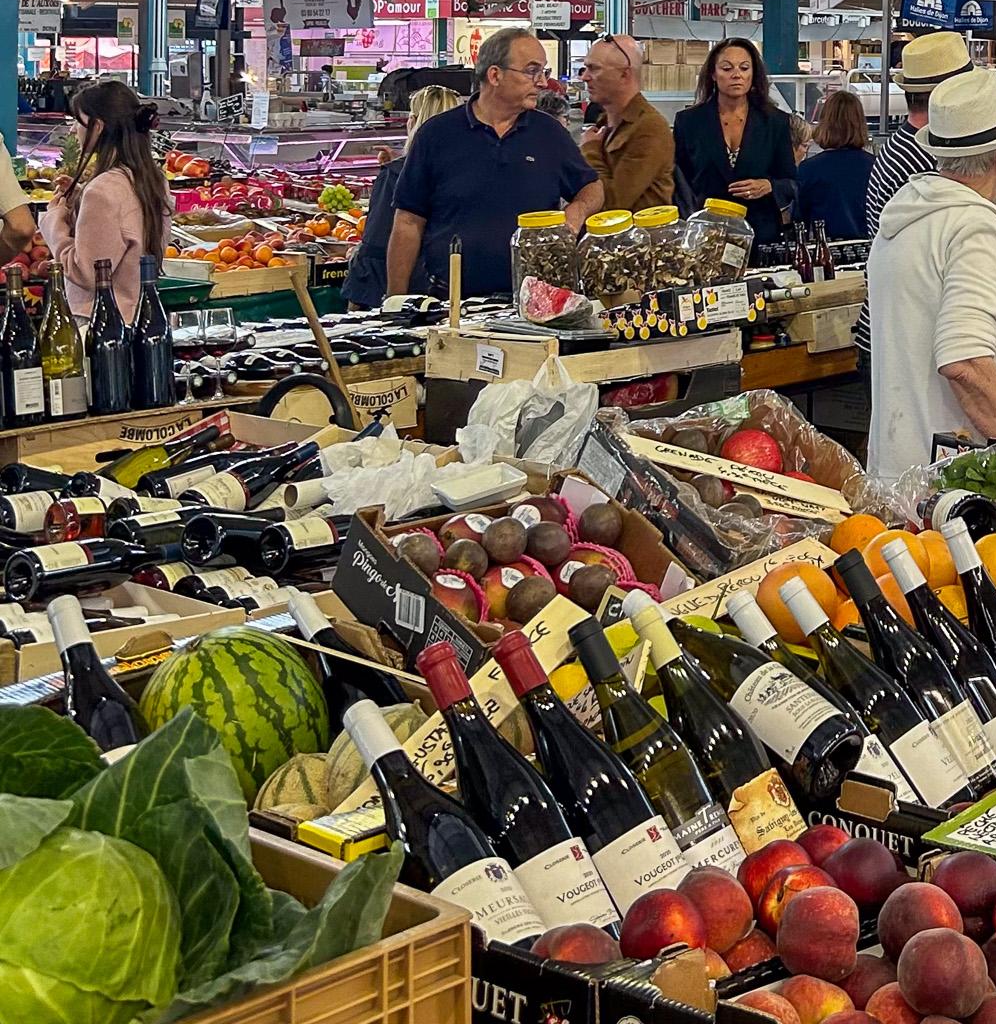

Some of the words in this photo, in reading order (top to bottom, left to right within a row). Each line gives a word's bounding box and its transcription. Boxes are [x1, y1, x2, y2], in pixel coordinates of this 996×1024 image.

[910, 4, 926, 15] Halles
[926, 8, 934, 16] de
[935, 9, 949, 20] Dijon
[971, 16, 977, 24] de
[977, 16, 989, 25] Dijon
[352, 550, 382, 583] Pingo
[634, 859, 676, 887] VOUGEOT
[556, 879, 598, 904] VOUGEOT
